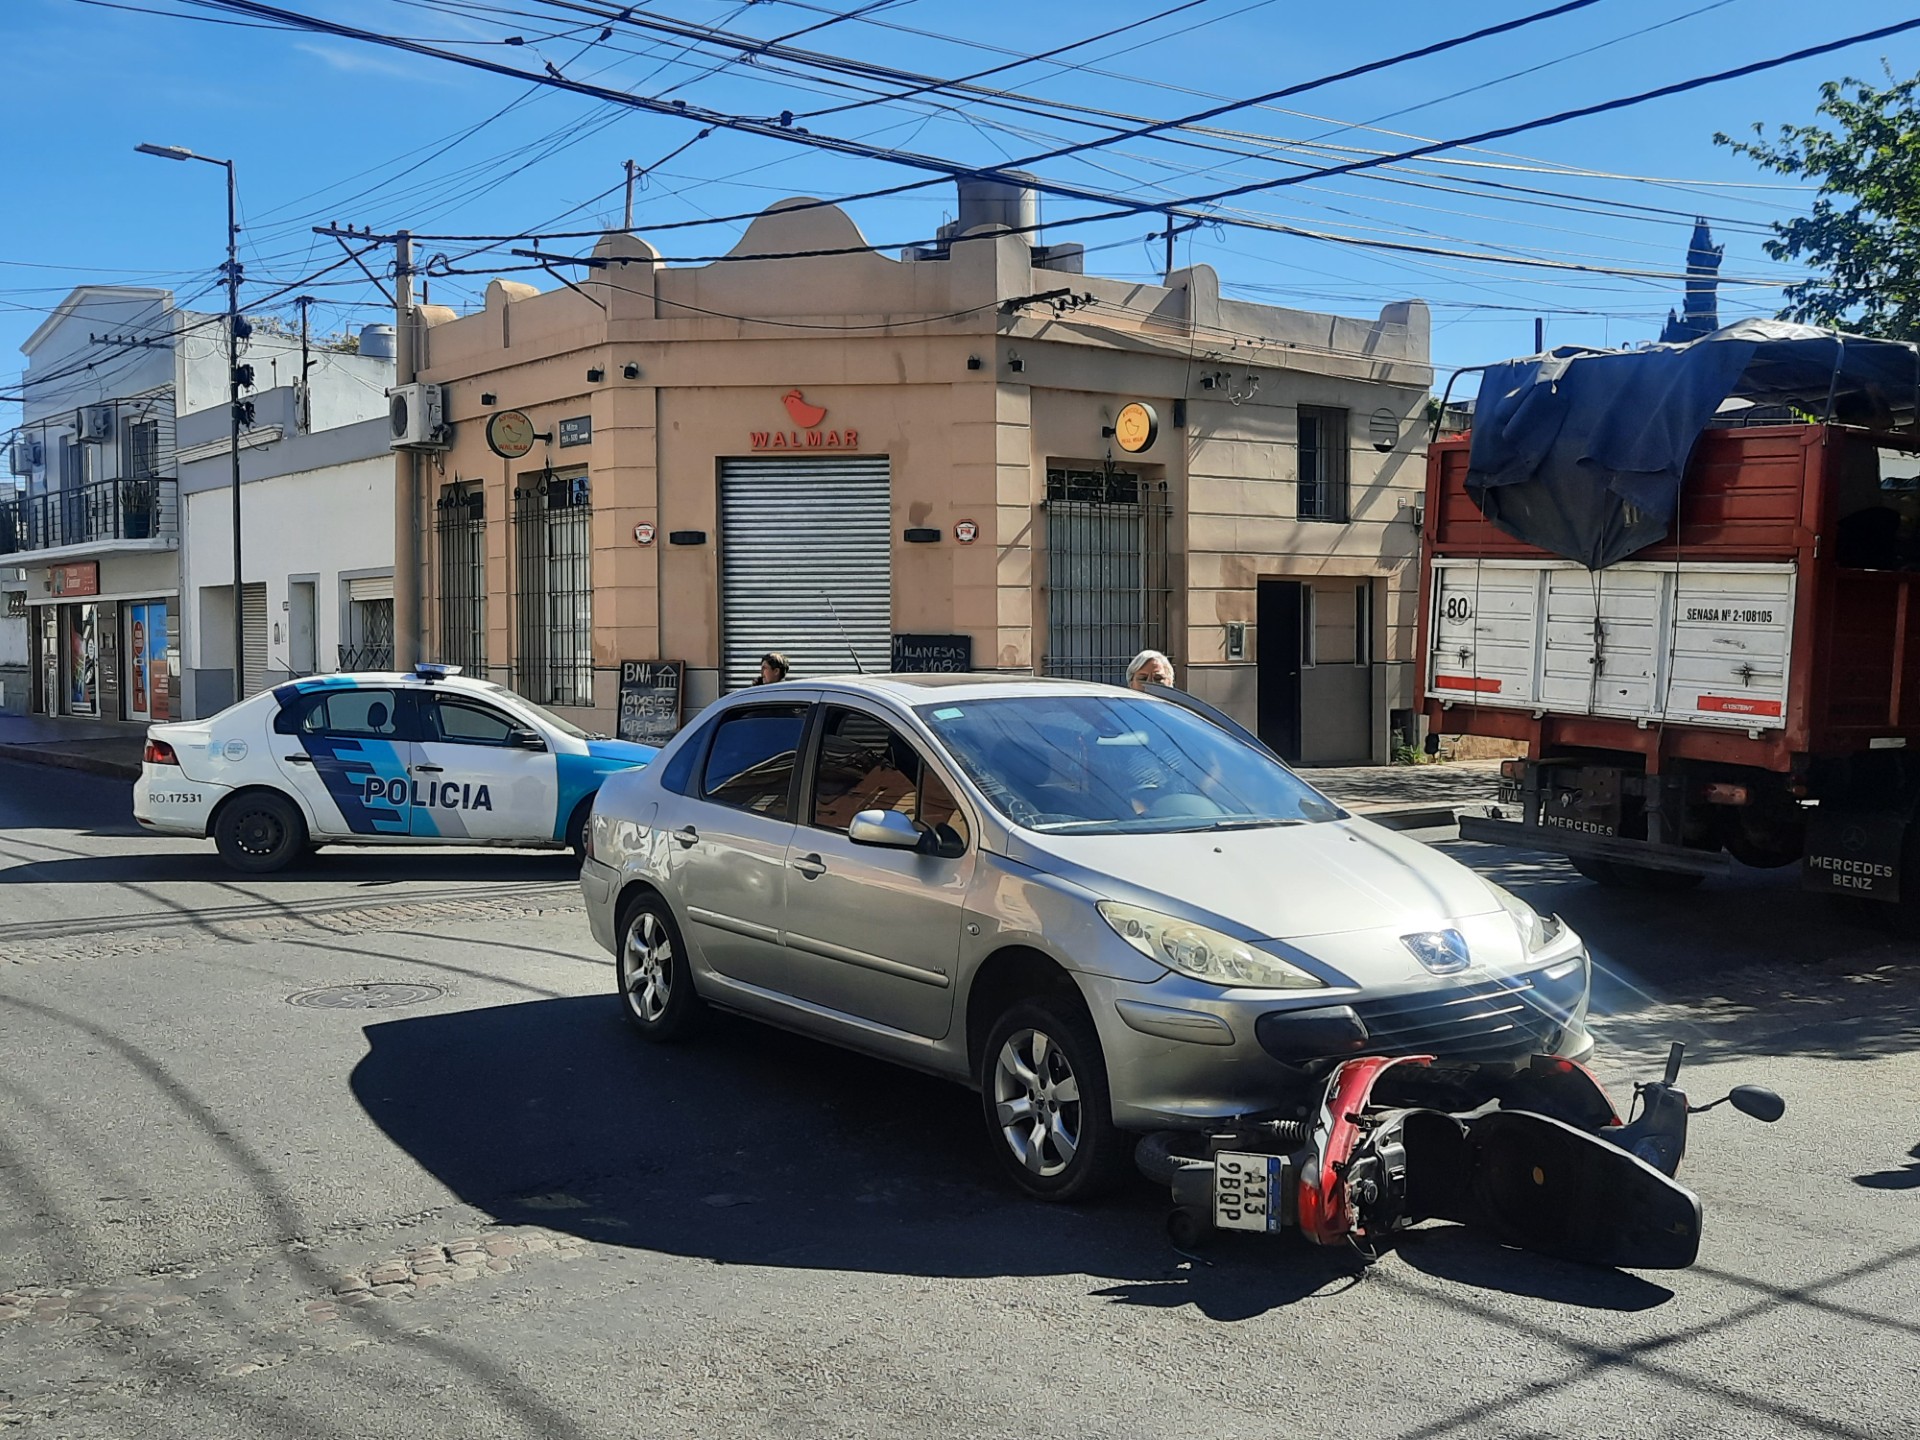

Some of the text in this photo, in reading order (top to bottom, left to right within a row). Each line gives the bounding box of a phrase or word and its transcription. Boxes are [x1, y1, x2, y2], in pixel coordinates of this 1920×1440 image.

[749, 430, 858, 448] WALMAR
[1447, 597, 1468, 619] 80
[1686, 607, 1719, 620] SENASA
[1733, 609, 1773, 623] 2-108105
[624, 662, 652, 684] BNA
[364, 776, 493, 811] POLICIA
[1547, 815, 1613, 836] MERCEDES
[1809, 855, 1893, 877] MERCEDES
[1832, 873, 1873, 890] BENZ
